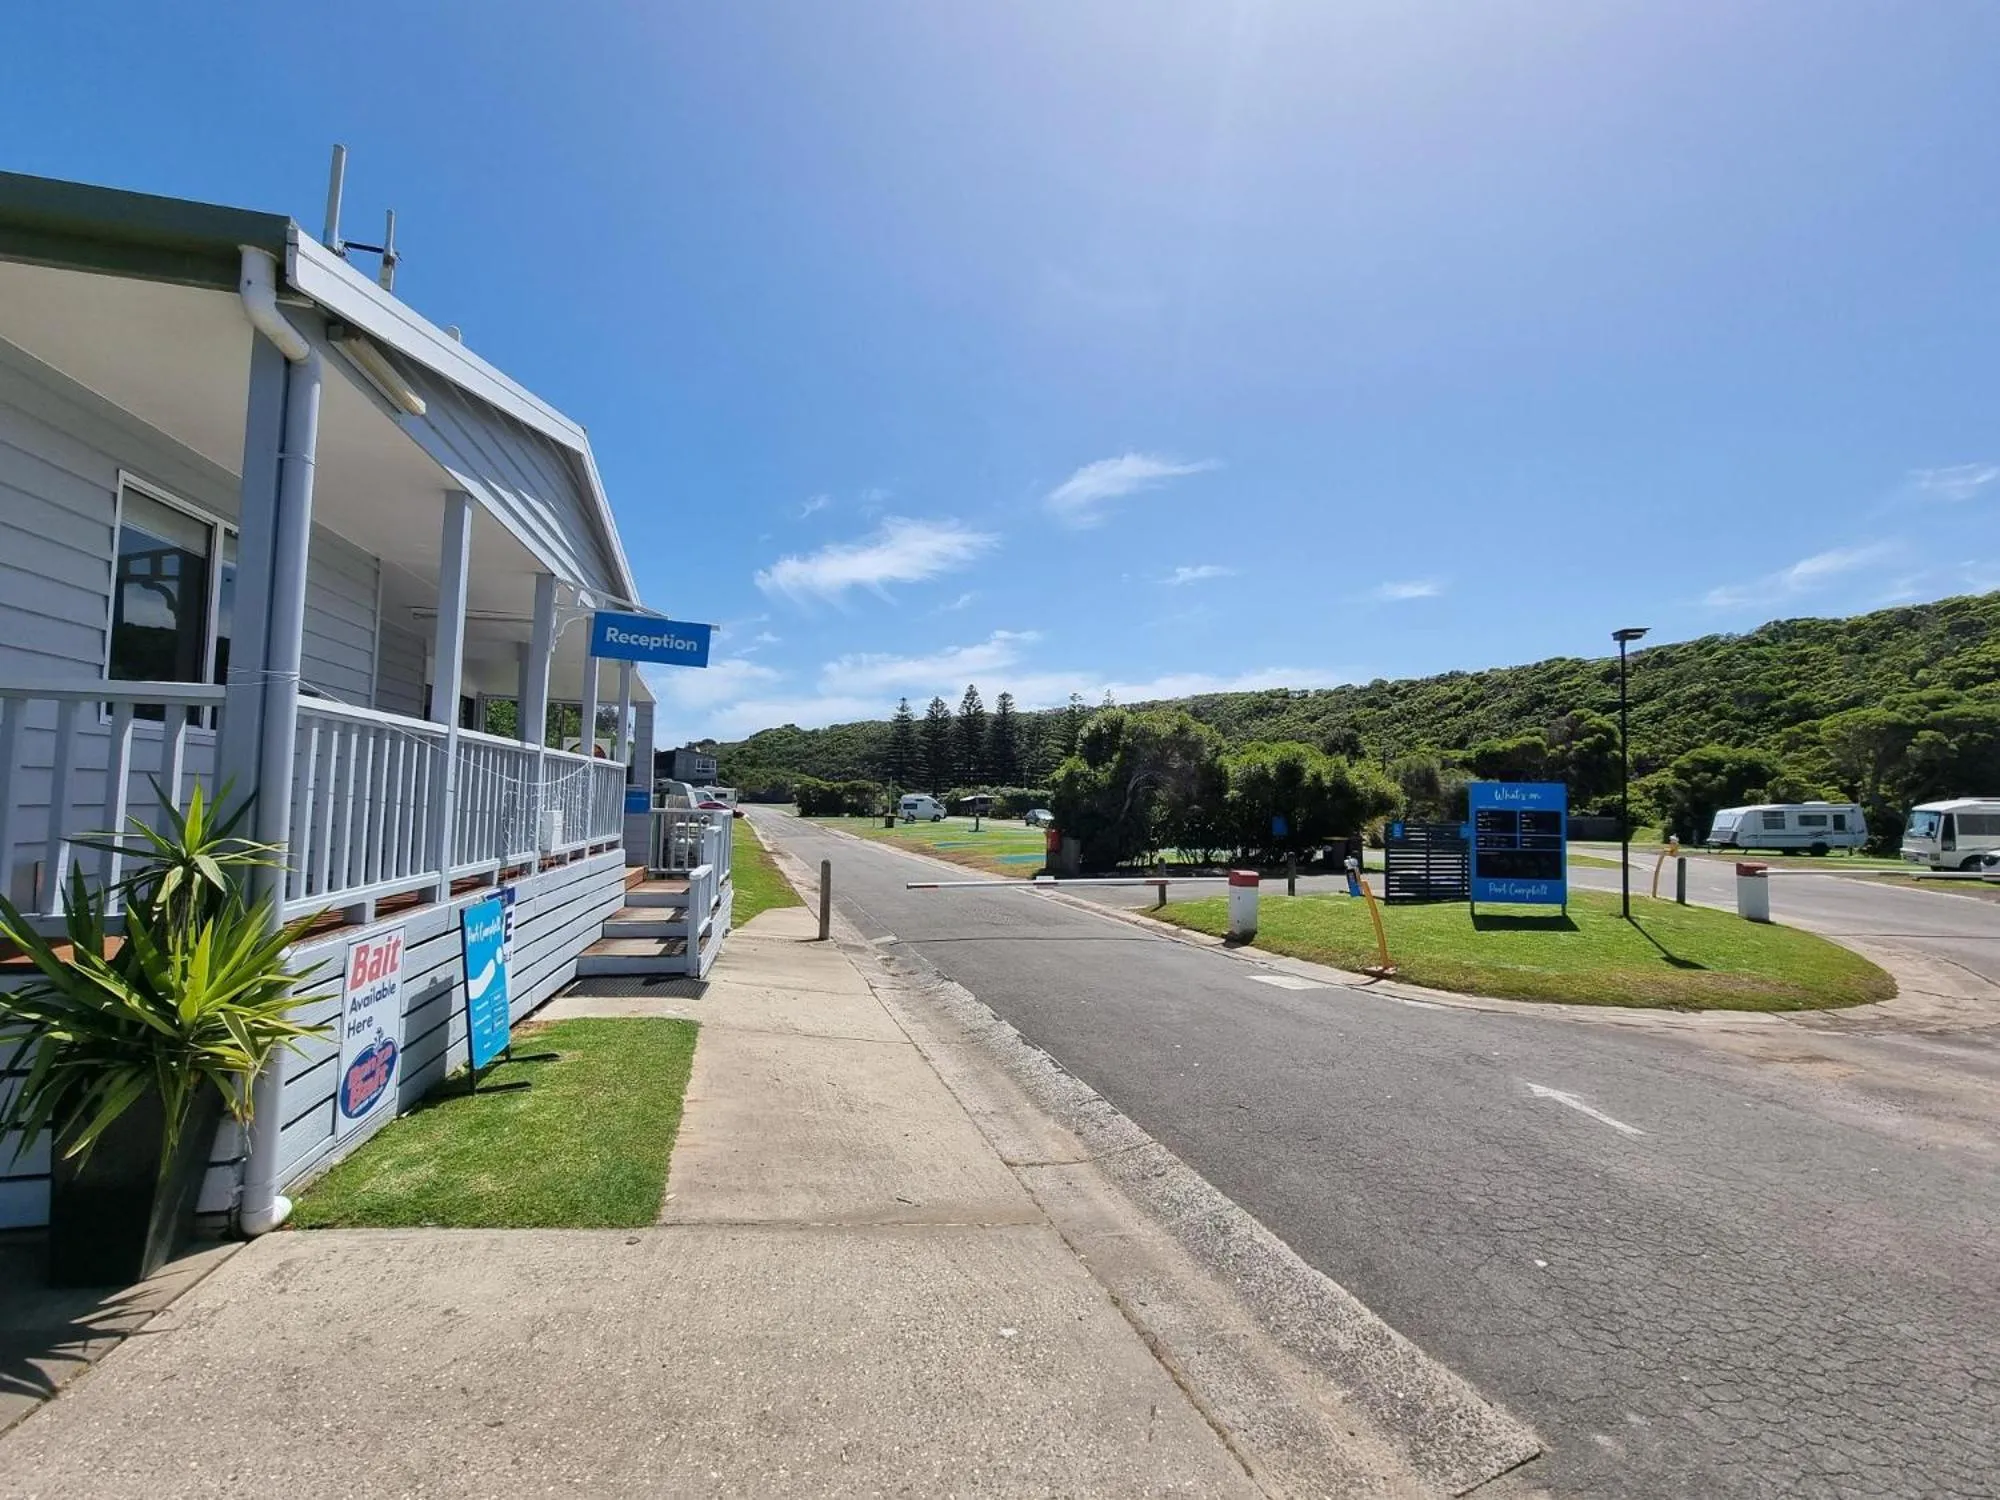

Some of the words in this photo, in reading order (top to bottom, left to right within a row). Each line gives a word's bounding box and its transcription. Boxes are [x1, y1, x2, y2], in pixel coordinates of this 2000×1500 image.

[605, 627, 698, 652] Reception
[349, 936, 402, 991] Bait
[348, 980, 397, 1015] Available
[347, 1015, 374, 1039] Here
